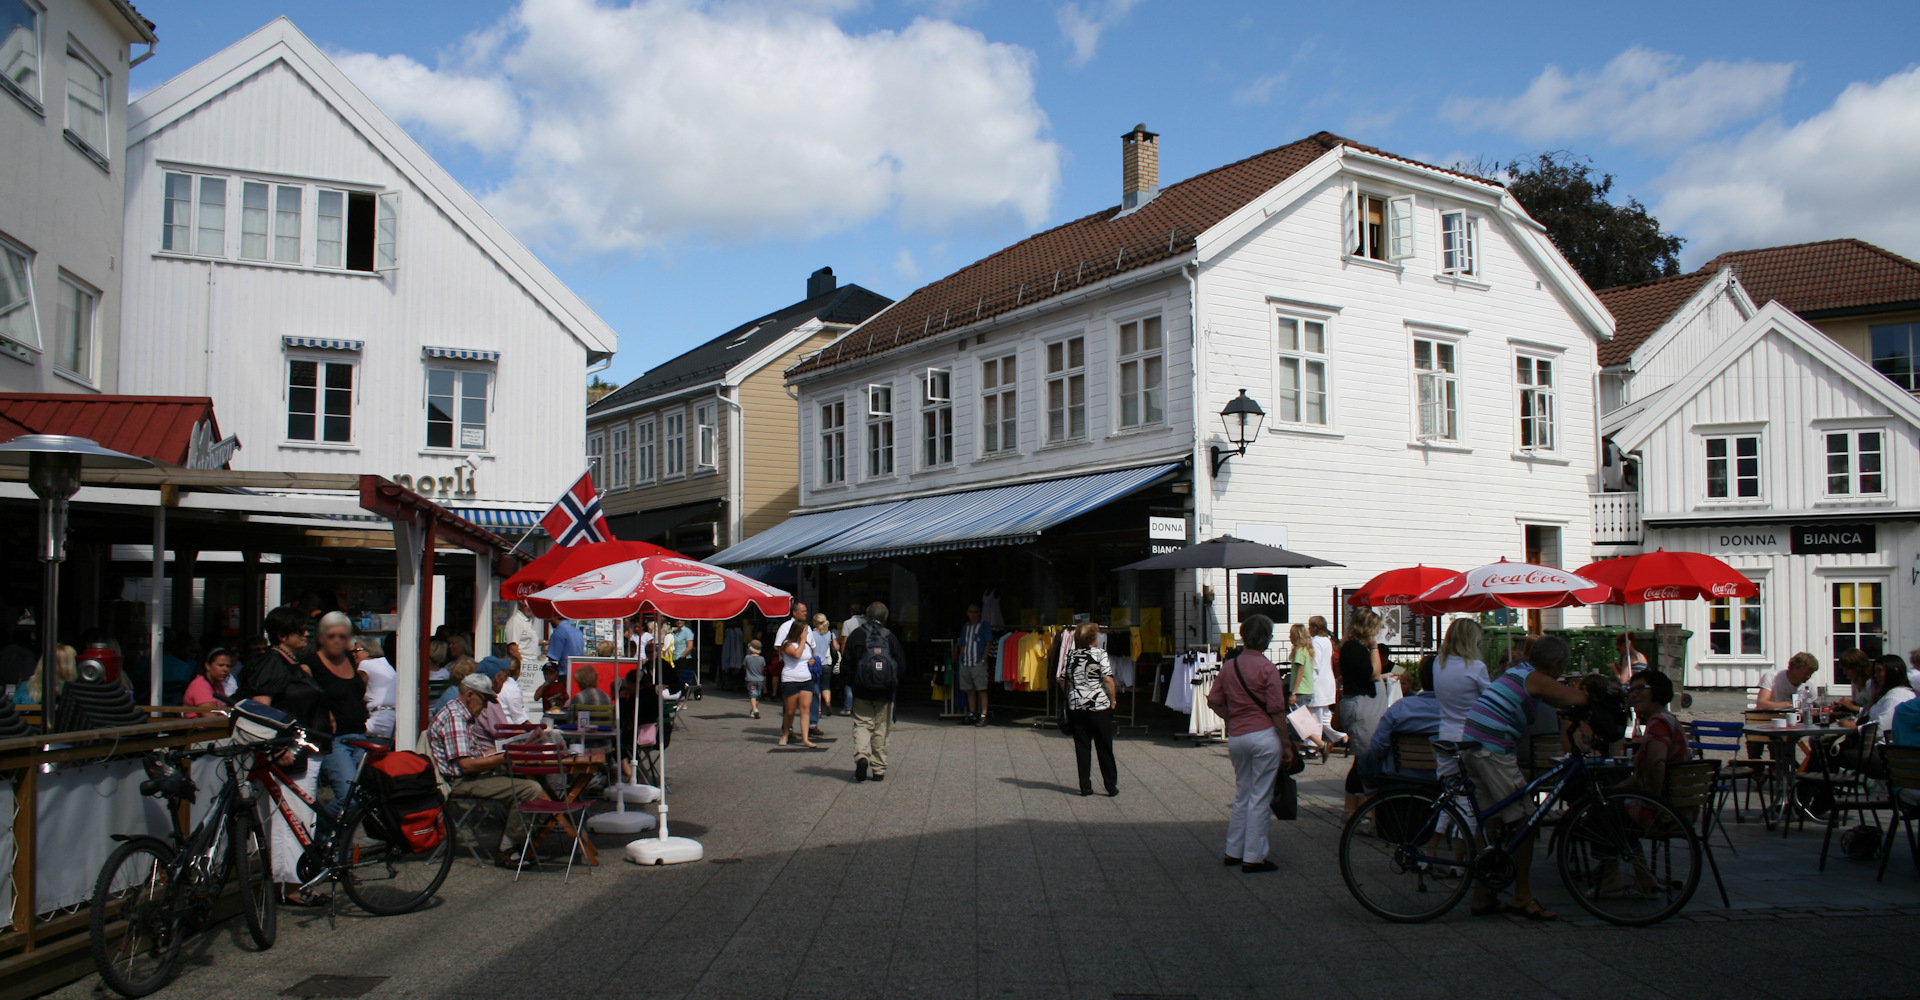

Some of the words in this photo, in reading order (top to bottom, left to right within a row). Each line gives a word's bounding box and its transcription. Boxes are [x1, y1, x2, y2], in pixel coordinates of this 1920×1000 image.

[392, 466, 477, 493] norli
[1151, 522, 1183, 532] DONNA
[1720, 534, 1777, 547] DONNA
[1803, 532, 1862, 545] BIANCA
[1482, 570, 1567, 588] Coca-Cola
[1240, 592, 1286, 605] BIANCA
[1643, 586, 1680, 600] Coca-Cola
